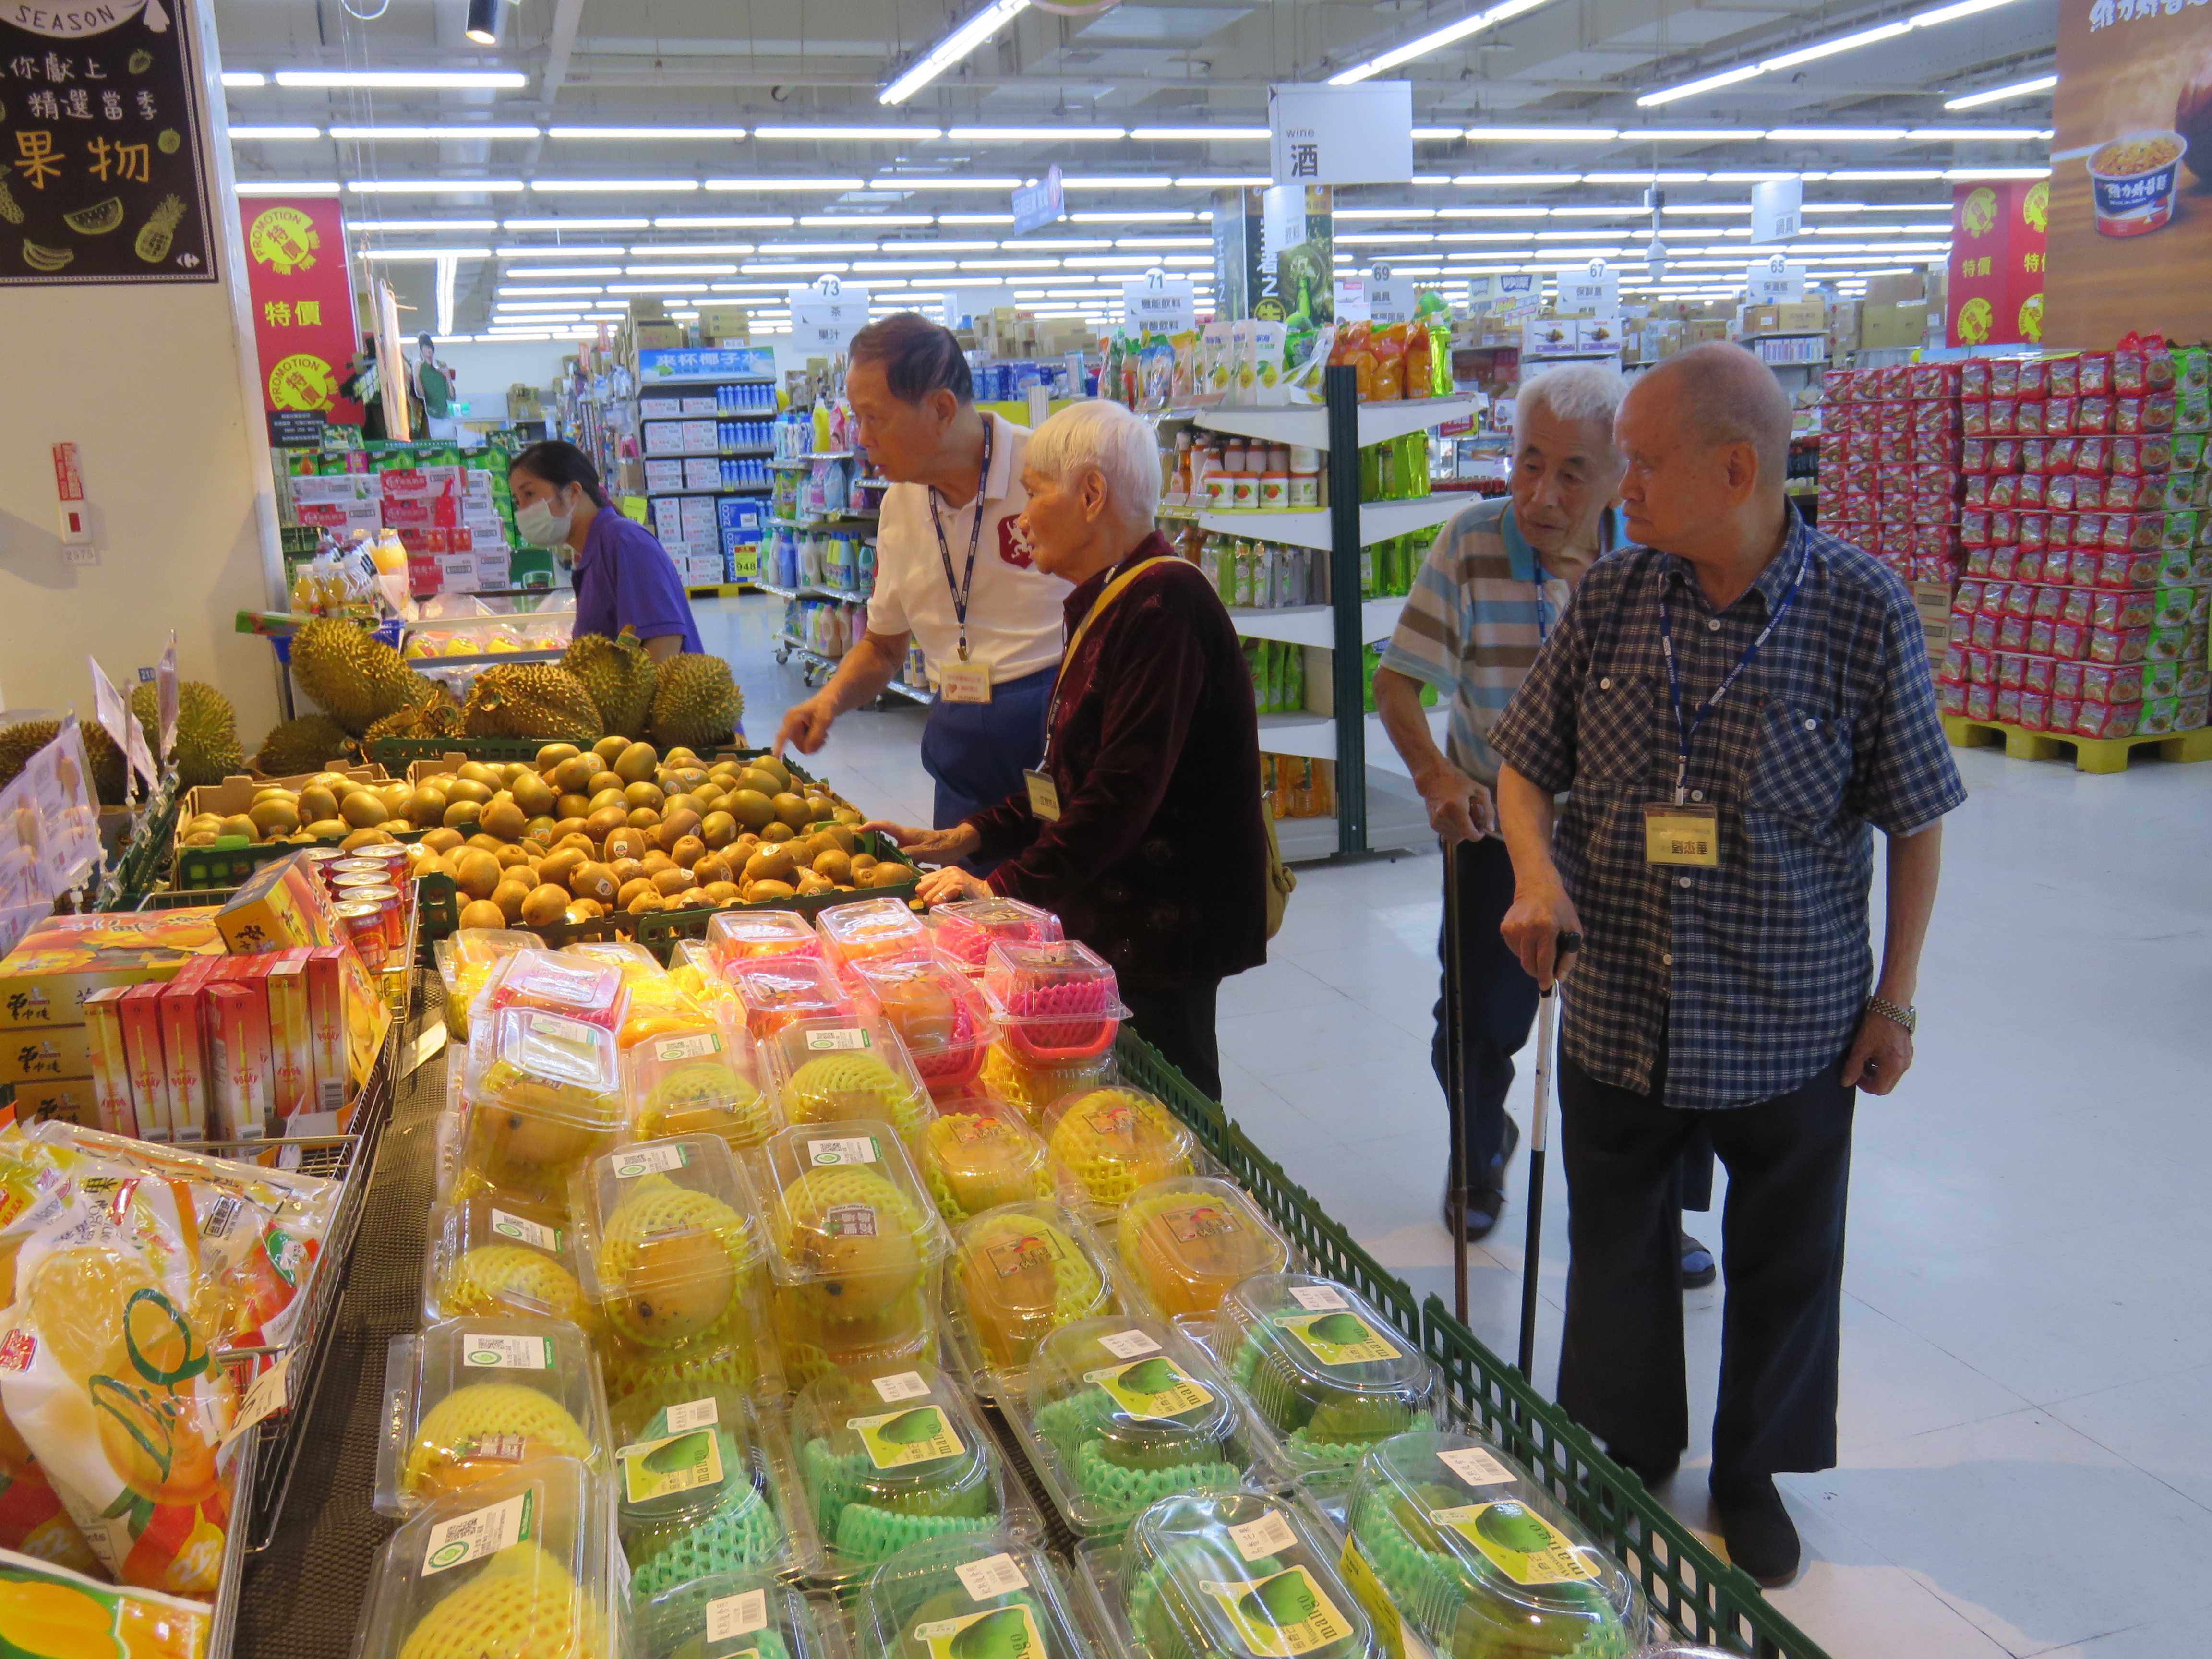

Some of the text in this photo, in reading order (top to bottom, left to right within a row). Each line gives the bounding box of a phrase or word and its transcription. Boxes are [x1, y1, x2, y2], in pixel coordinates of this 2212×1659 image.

[16, 4, 116, 31] SEASON
[28, 89, 158, 121] 精選當季
[1286, 128, 1314, 137] wine
[15, 130, 150, 190] 果物
[1290, 144, 1318, 177] 酒
[252, 211, 302, 258] PROMOTION
[1374, 266, 1390, 281] 69
[1590, 264, 1604, 277] 67
[1771, 260, 1784, 273] 65
[2024, 252, 2046, 273] 特
[821, 280, 840, 296] 73
[1147, 274, 1163, 289] 71
[264, 301, 321, 326] 特價
[272, 358, 320, 403] PROMOTION
[926, 1424, 953, 1455] mango
[1528, 1523, 1585, 1576] mango
[1297, 1594, 1338, 1640] mango
[1010, 1634, 1031, 1659] ngo
